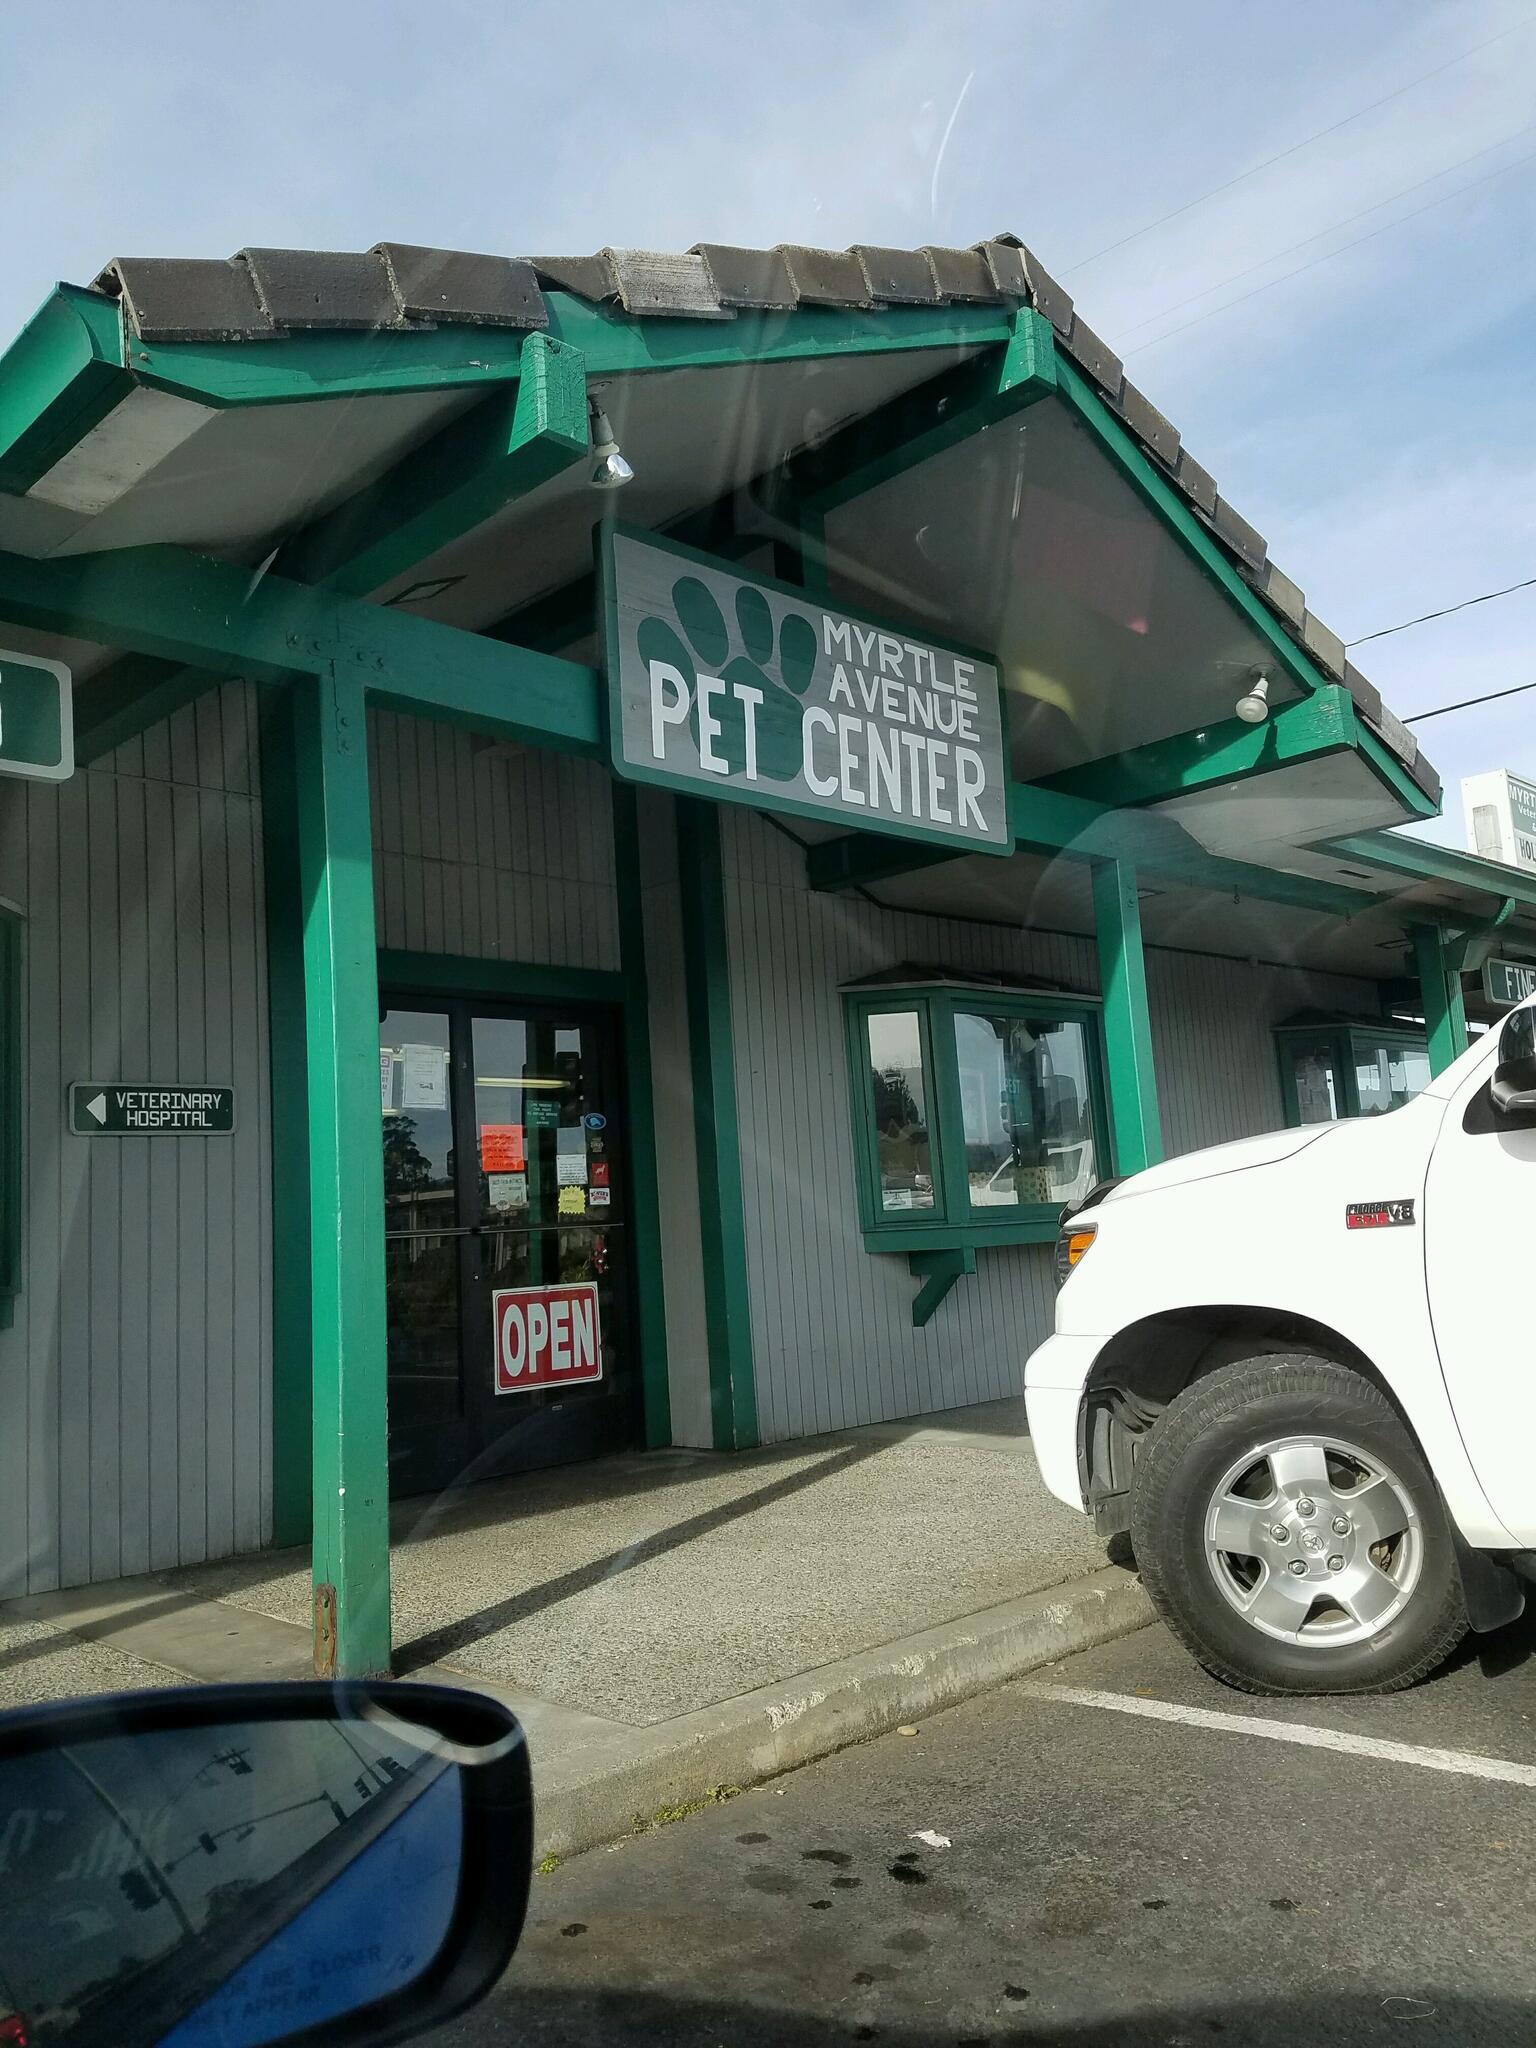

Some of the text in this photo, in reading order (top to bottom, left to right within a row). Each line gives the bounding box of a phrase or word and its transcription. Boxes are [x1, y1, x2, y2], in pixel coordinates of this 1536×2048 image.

[822, 614, 977, 701] MYRTLE
[828, 663, 981, 742] AVENUE
[649, 659, 989, 832] PET CENTER
[116, 1092, 222, 1109] VETERINARY
[126, 1110, 213, 1126] HOSPITAL
[1386, 1203, 1412, 1223] V8
[502, 1298, 594, 1378] OPEN
